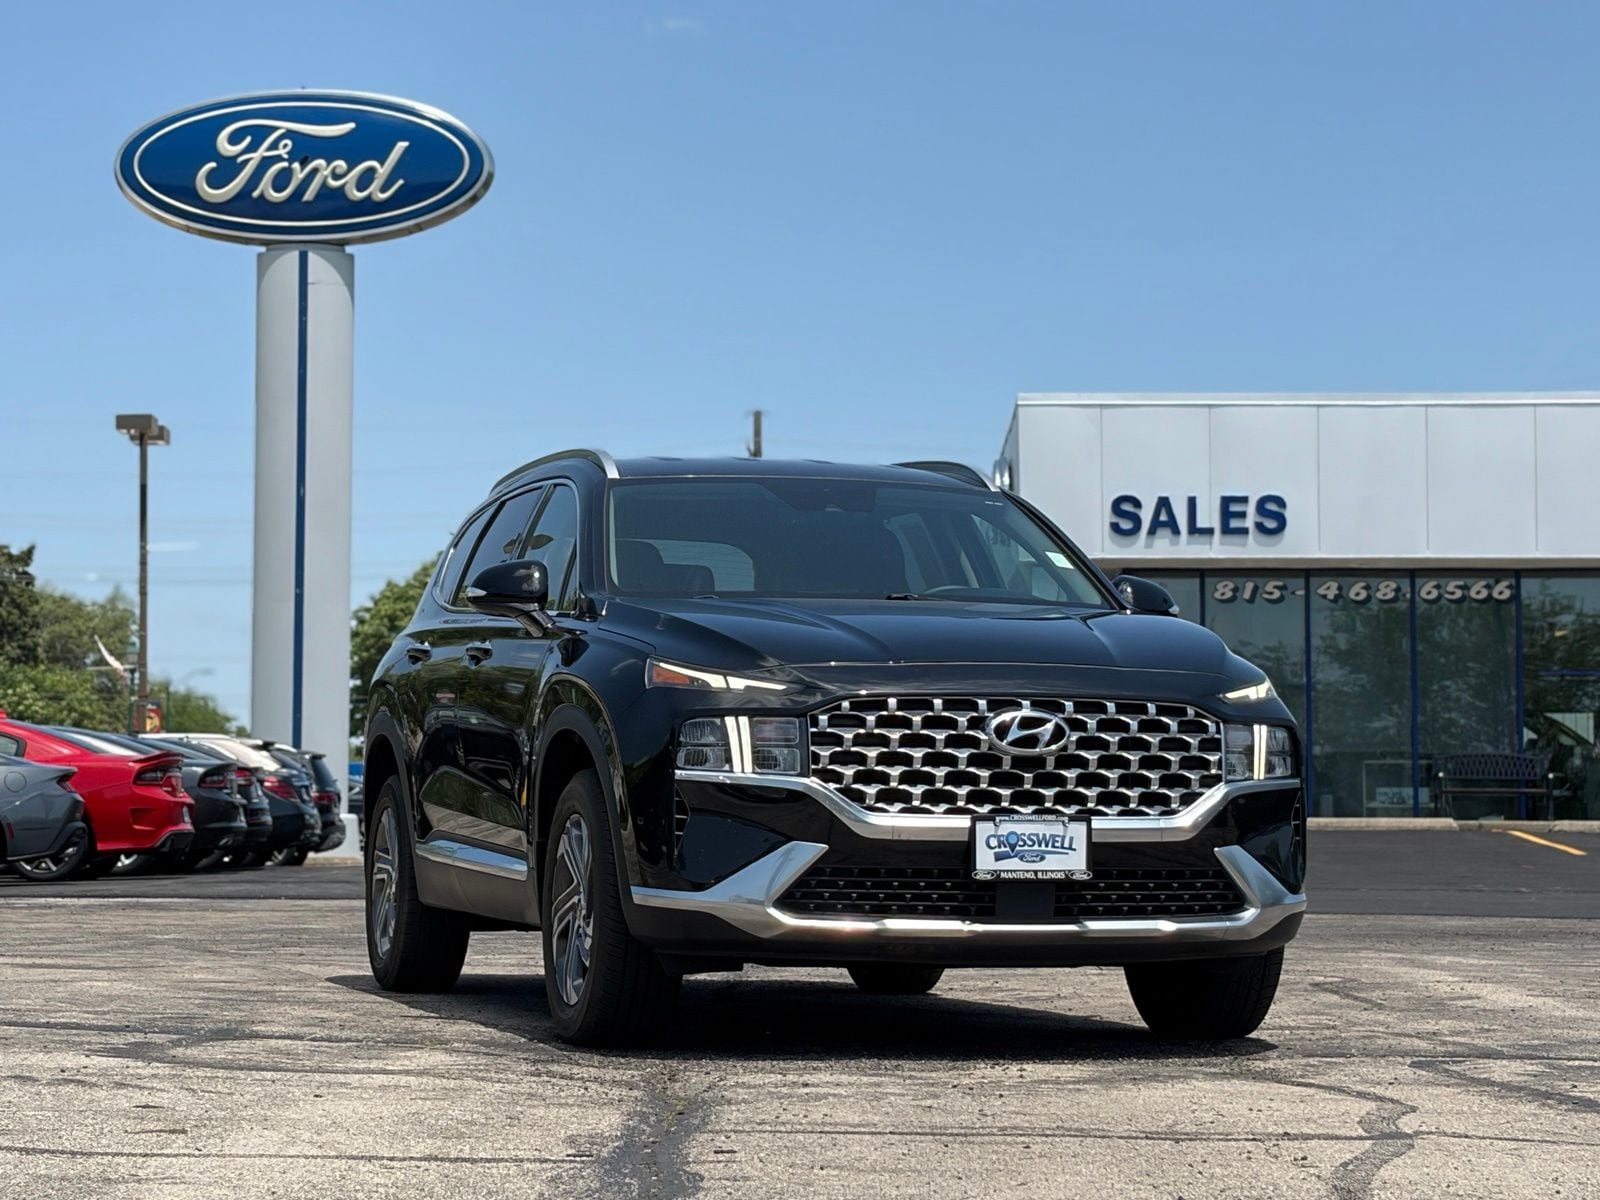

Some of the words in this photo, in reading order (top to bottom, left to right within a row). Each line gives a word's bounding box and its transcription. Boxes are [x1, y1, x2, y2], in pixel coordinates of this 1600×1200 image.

[195, 119, 410, 203] Ford
[1110, 494, 1288, 537] SALES
[985, 831, 1076, 852] CROSSWELL
[1000, 871, 1036, 879] MANTENO,
[1038, 871, 1065, 879] ILLINOIS
